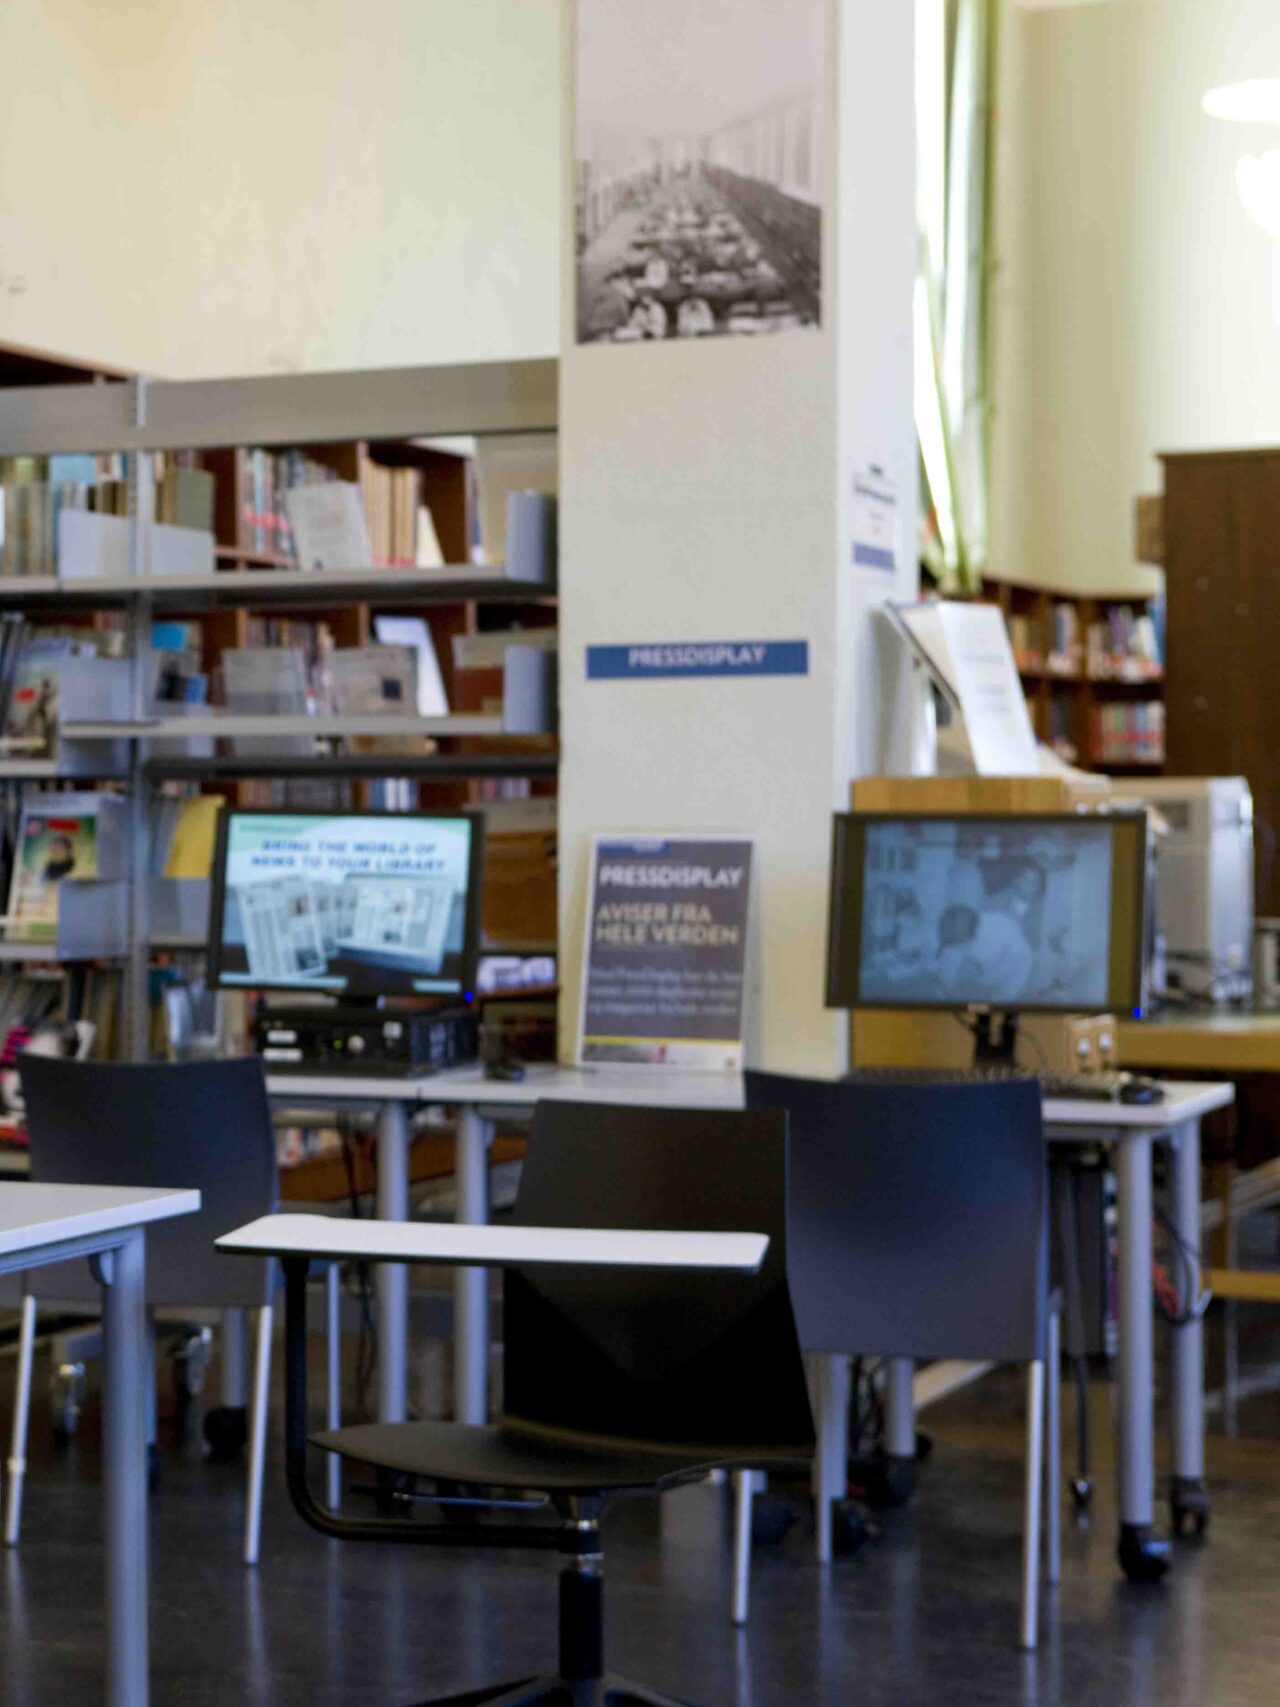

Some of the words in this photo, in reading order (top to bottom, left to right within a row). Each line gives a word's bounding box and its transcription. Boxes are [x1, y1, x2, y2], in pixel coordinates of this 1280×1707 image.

[628, 645, 767, 667] PRESSDISPLAY
[599, 865, 743, 888] PRESSDISPLAY
[596, 902, 667, 922] AVISER
[671, 903, 712, 923] FRA
[594, 923, 647, 943] HELE
[651, 924, 740, 946] VERDEN
